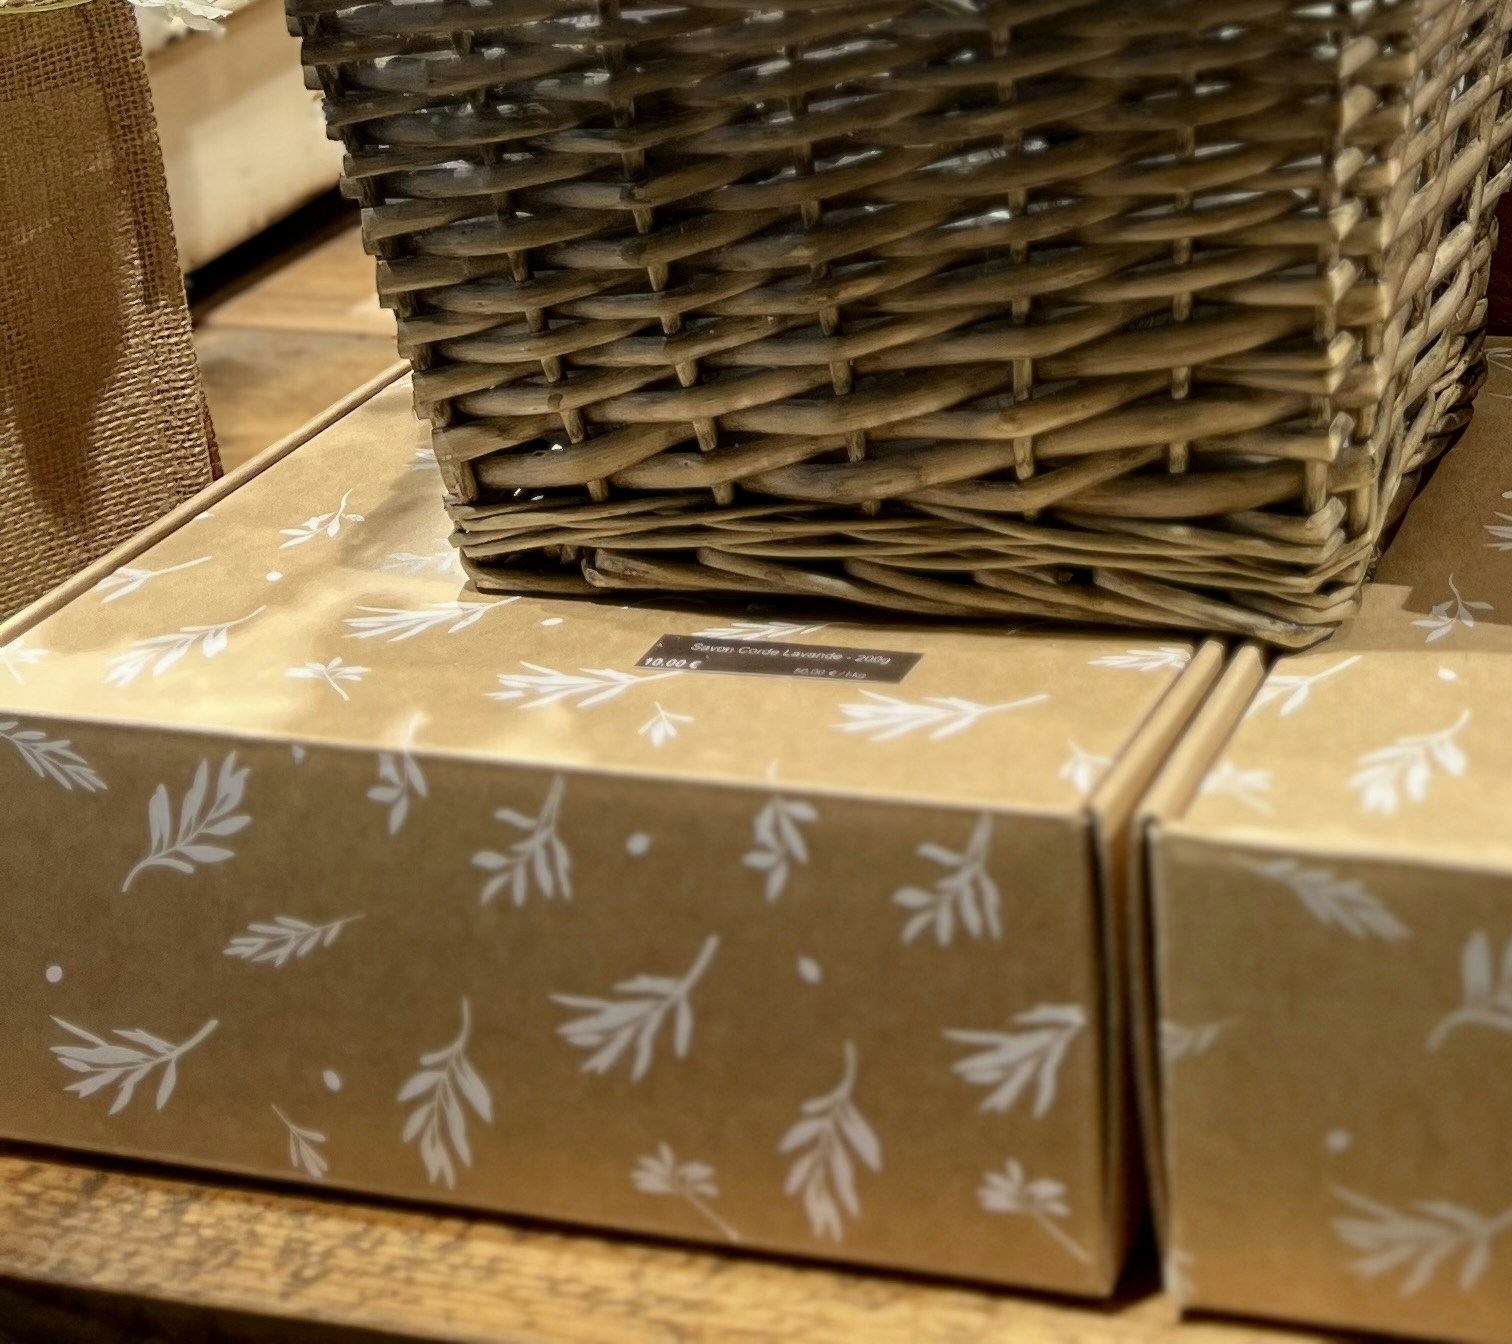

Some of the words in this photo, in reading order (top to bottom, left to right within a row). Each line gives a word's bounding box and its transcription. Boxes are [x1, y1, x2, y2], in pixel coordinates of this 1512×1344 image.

[691, 642, 734, 654] Savon
[738, 645, 780, 657] Corde
[782, 648, 844, 661] Lavande
[854, 653, 892, 666] 200g
[644, 657, 687, 668] 10.00
[689, 659, 703, 670] €
